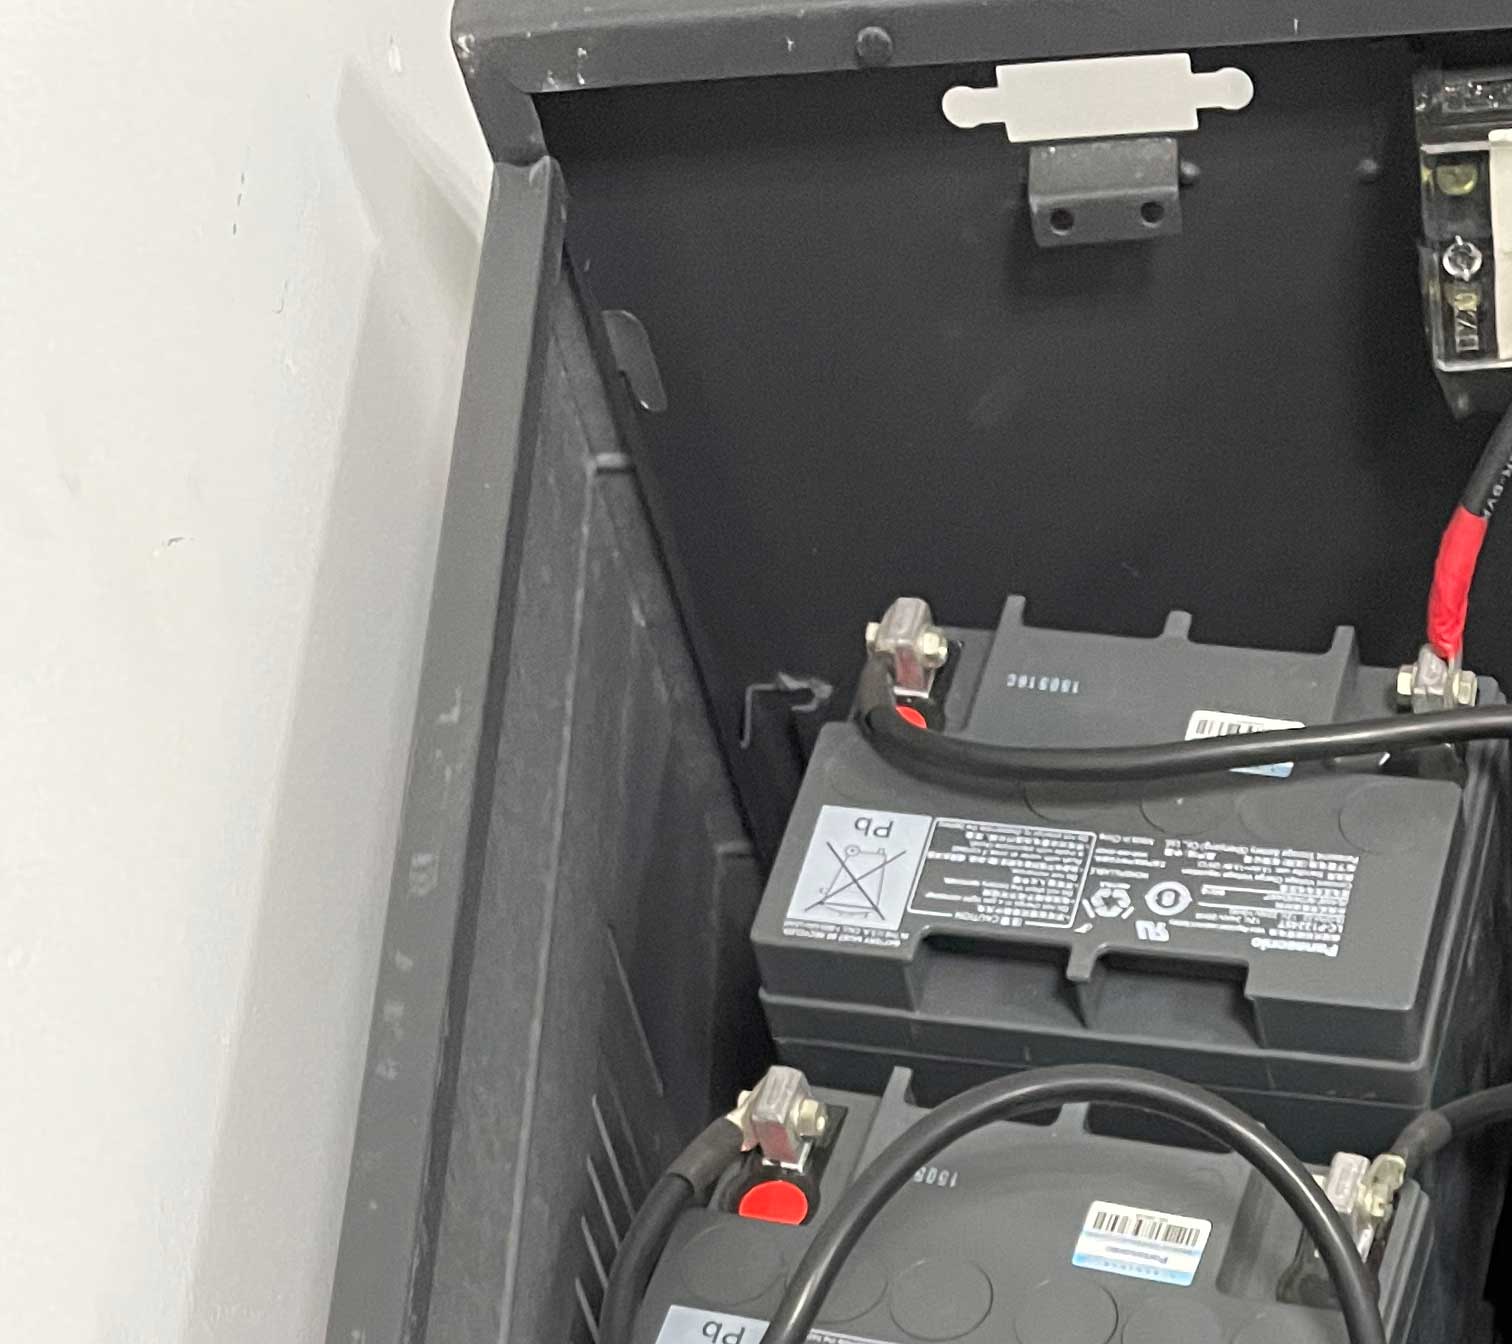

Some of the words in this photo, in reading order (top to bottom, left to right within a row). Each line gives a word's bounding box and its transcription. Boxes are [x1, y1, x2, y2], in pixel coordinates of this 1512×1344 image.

[852, 815, 893, 839] Pb
[955, 909, 1001, 923] CAUTION
[1105, 1245, 1167, 1264] Panasonic
